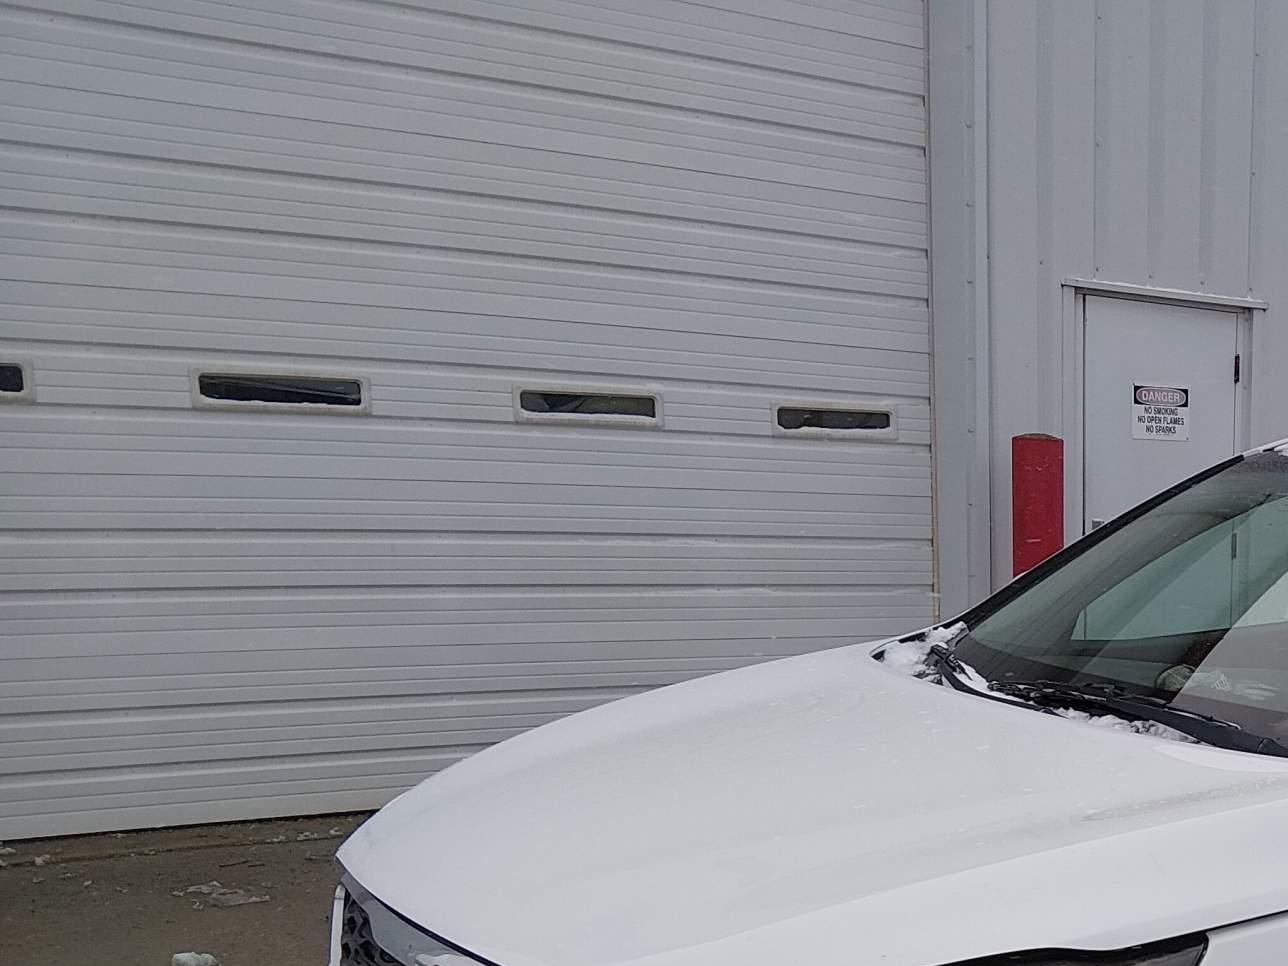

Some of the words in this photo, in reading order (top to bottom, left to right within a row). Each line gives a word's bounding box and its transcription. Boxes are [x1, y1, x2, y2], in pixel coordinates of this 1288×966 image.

[1142, 391, 1180, 402] DANGER
[1144, 406, 1152, 415] NO
[1153, 407, 1178, 416] SMOKING
[1138, 416, 1146, 424] NO
[1146, 416, 1162, 424] OPEN
[1163, 417, 1184, 426] FLAMES
[1146, 425, 1154, 433] NO
